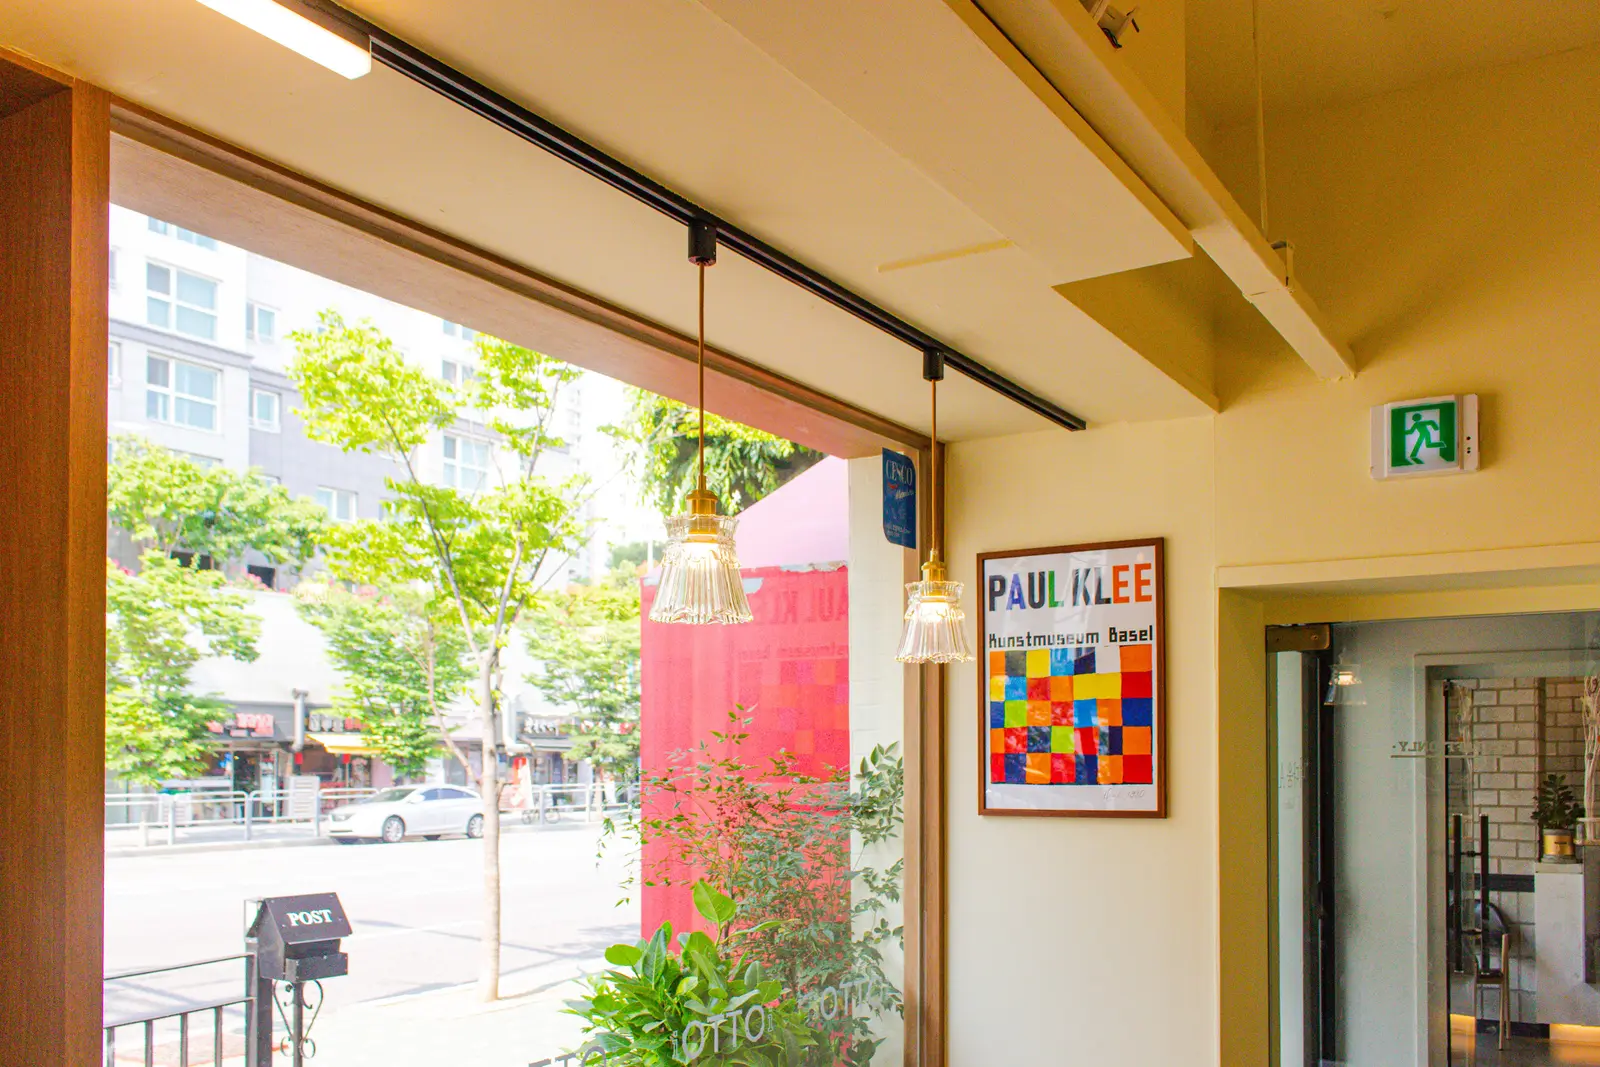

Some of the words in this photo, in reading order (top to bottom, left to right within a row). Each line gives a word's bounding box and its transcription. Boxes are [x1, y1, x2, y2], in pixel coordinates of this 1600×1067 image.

[886, 459, 913, 486] CESCO
[988, 570, 1064, 612] PAUL
[1072, 562, 1153, 607] KLEE
[988, 631, 1099, 649] Kunstmuseum
[1109, 624, 1153, 643] Basel
[285, 908, 333, 927] POST
